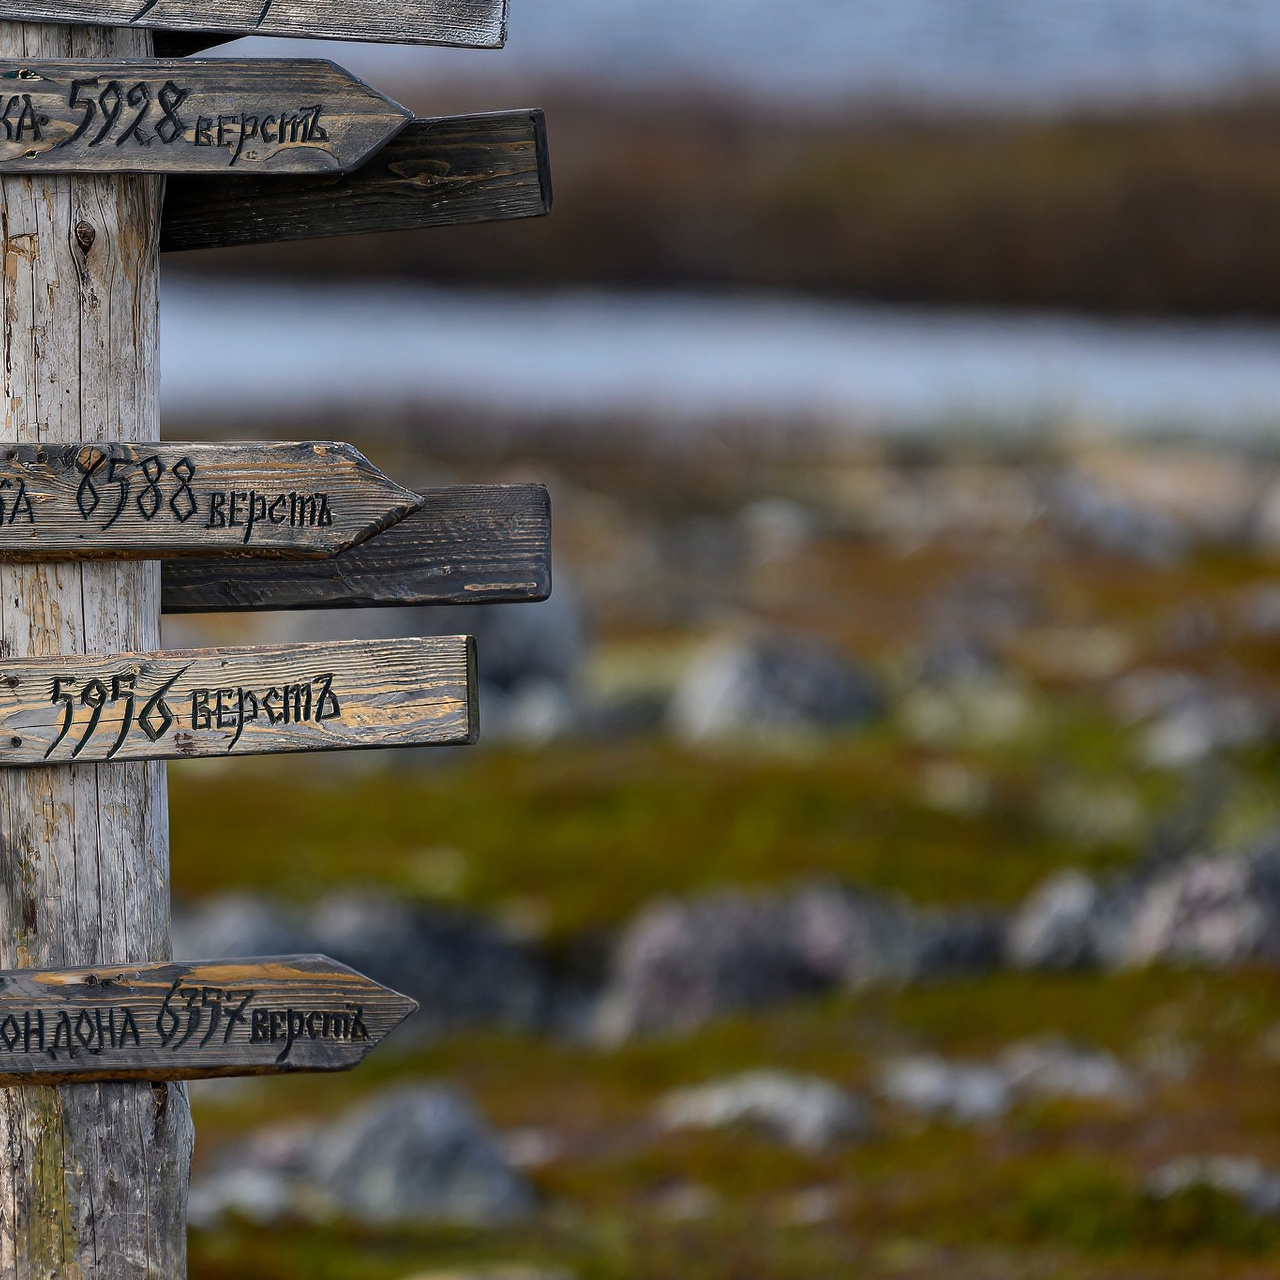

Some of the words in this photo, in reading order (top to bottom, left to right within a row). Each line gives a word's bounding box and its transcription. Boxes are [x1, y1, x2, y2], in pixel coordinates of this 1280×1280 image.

[57, 79, 192, 148] 5928
[75, 445, 198, 532] 8588
[42, 660, 196, 761] 5956
[156, 977, 254, 1052] 6357
